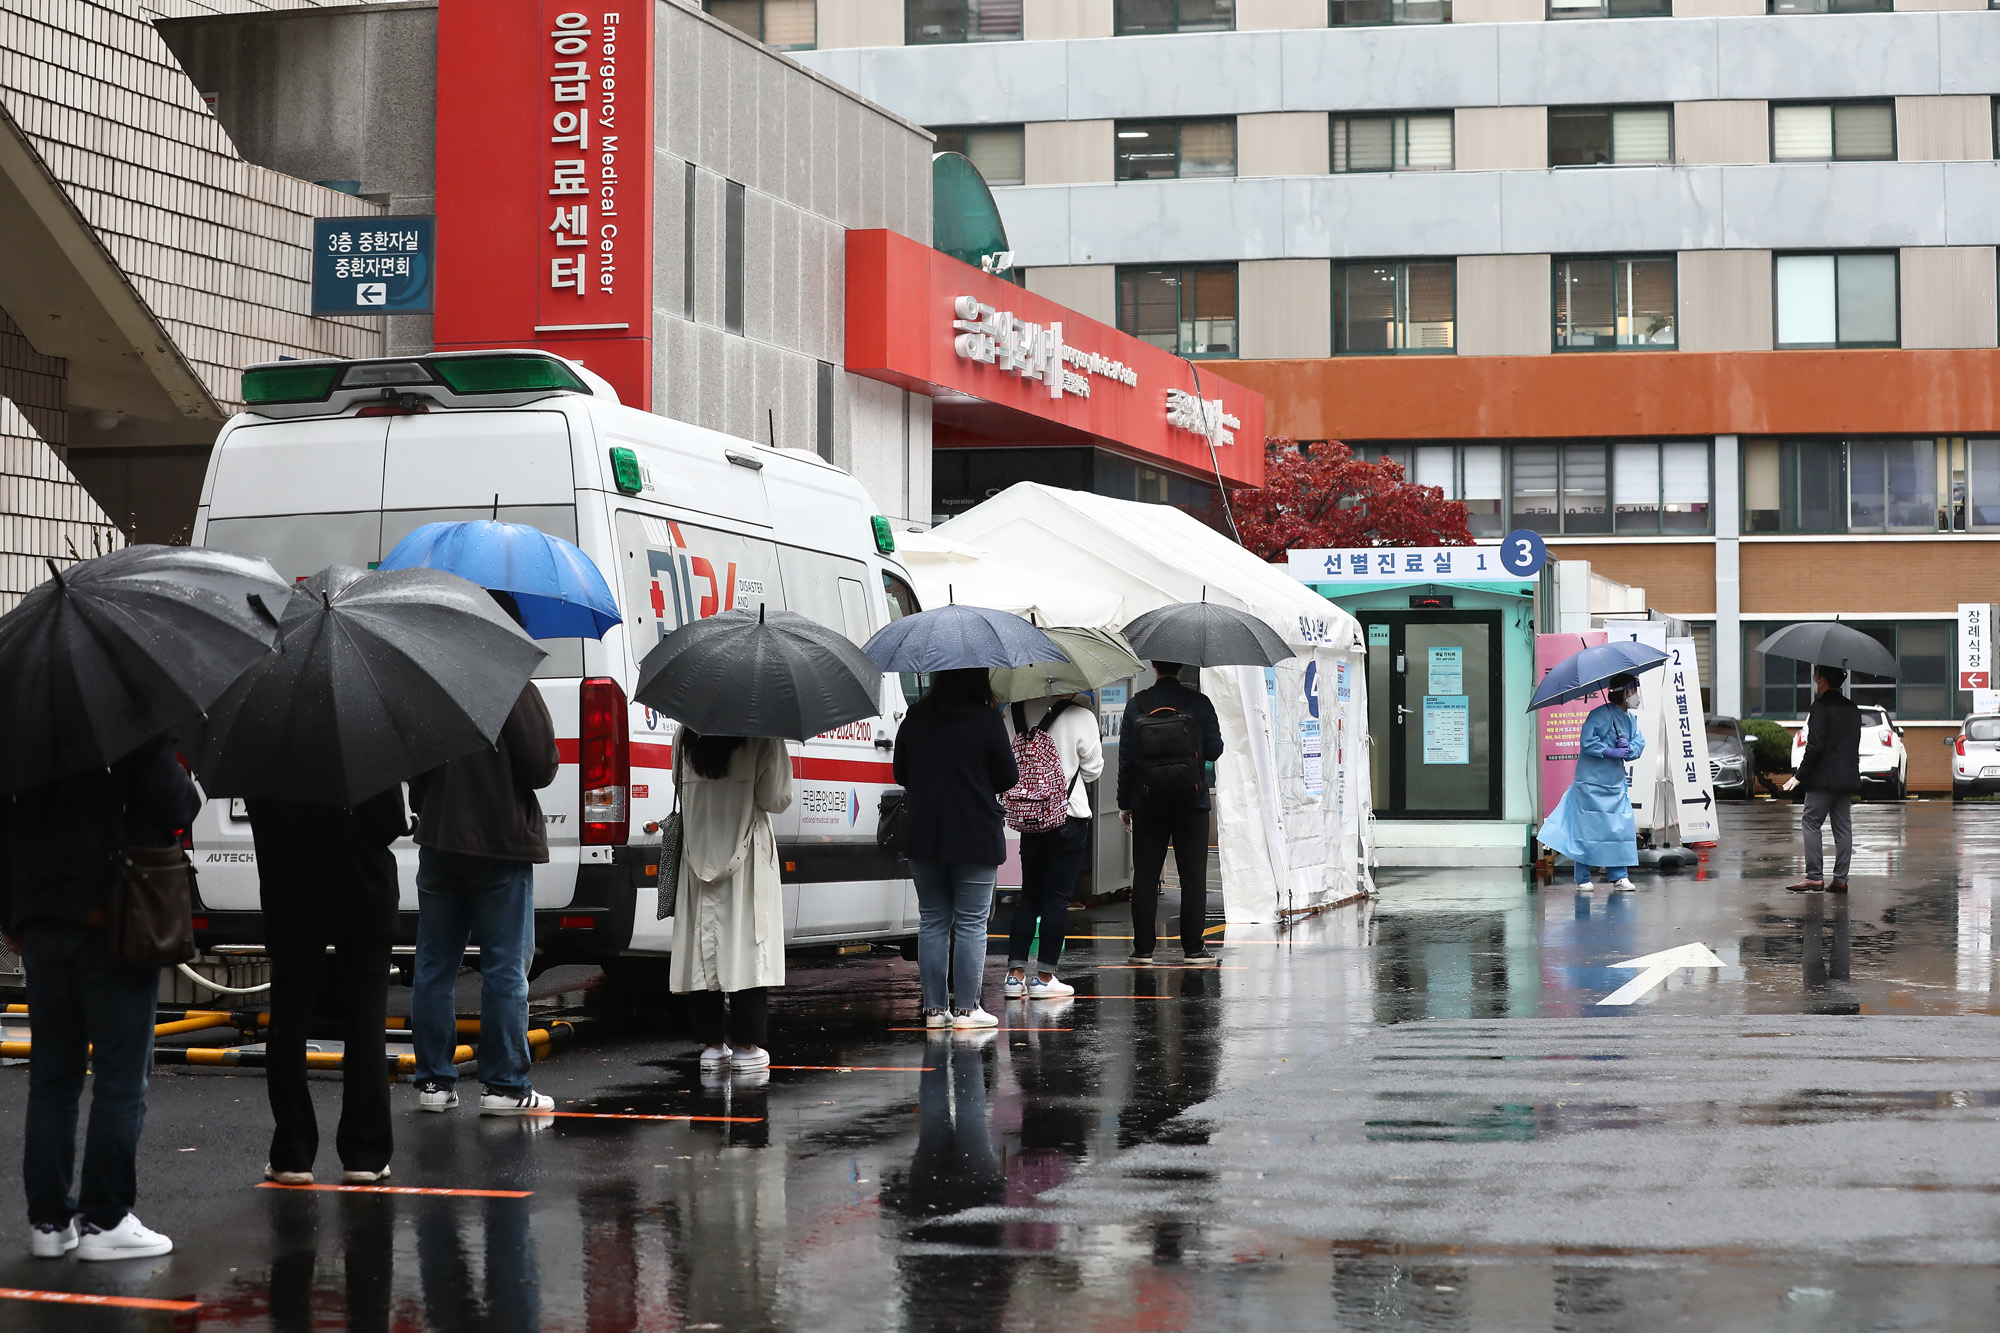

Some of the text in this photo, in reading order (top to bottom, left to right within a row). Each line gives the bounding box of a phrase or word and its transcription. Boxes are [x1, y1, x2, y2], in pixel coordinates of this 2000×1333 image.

[548, 11, 592, 296] 응급의료센터
[599, 12, 620, 295] Emergency Medical Center
[328, 230, 419, 253] 3층 중환자실
[335, 256, 410, 279] 중환자면회
[953, 295, 1063, 399] 응급의료센터
[1062, 343, 1093, 375] mergency
[1092, 352, 1119, 380] Medical
[1117, 362, 1138, 387] Center
[1323, 552, 1488, 575] 선별진료실 1
[1514, 539, 1534, 567] 3
[739, 579, 765, 594] DISASTER
[737, 595, 749, 608] AND
[1967, 610, 1981, 668] 장례식장
[1672, 649, 1682, 666] 2
[1673, 671, 1697, 783] 선별진료실
[803, 790, 847, 812] 국립중앙의료원
[802, 816, 816, 824] national
[205, 853, 255, 863] AUTECH
